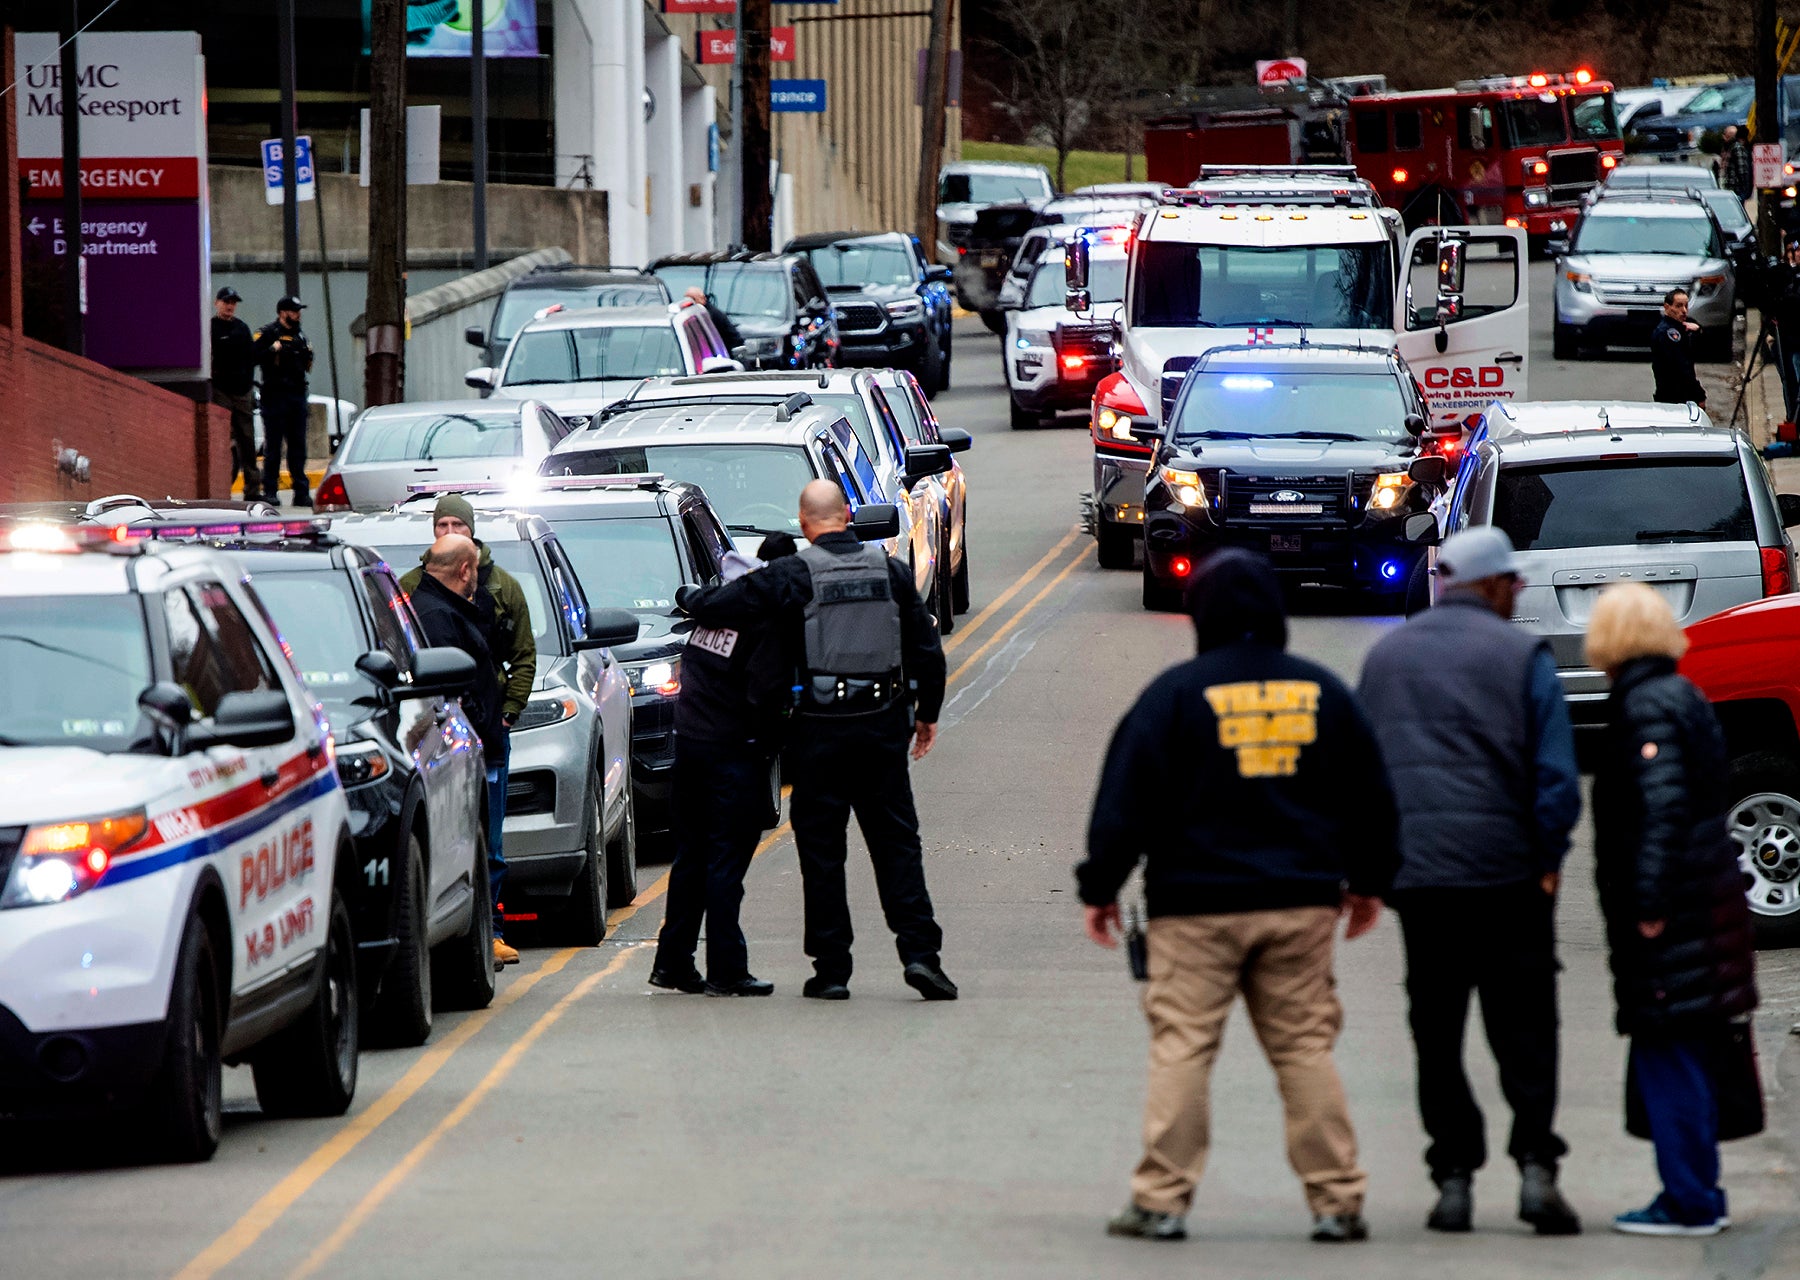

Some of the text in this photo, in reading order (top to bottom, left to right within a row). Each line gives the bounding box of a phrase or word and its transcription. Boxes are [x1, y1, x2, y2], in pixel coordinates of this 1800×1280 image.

[711, 39, 737, 55] Exi
[770, 91, 817, 104] rance
[269, 144, 305, 161] Bs
[28, 168, 164, 187] EMRGENCY
[53, 218, 148, 237] Eergency
[53, 239, 158, 255] Dpartment
[1424, 367, 1504, 389] C&D
[1464, 389, 1515, 399] Recovery
[239, 817, 315, 912] POLICE
[364, 856, 390, 887] 11
[278, 896, 315, 948] UNIT
